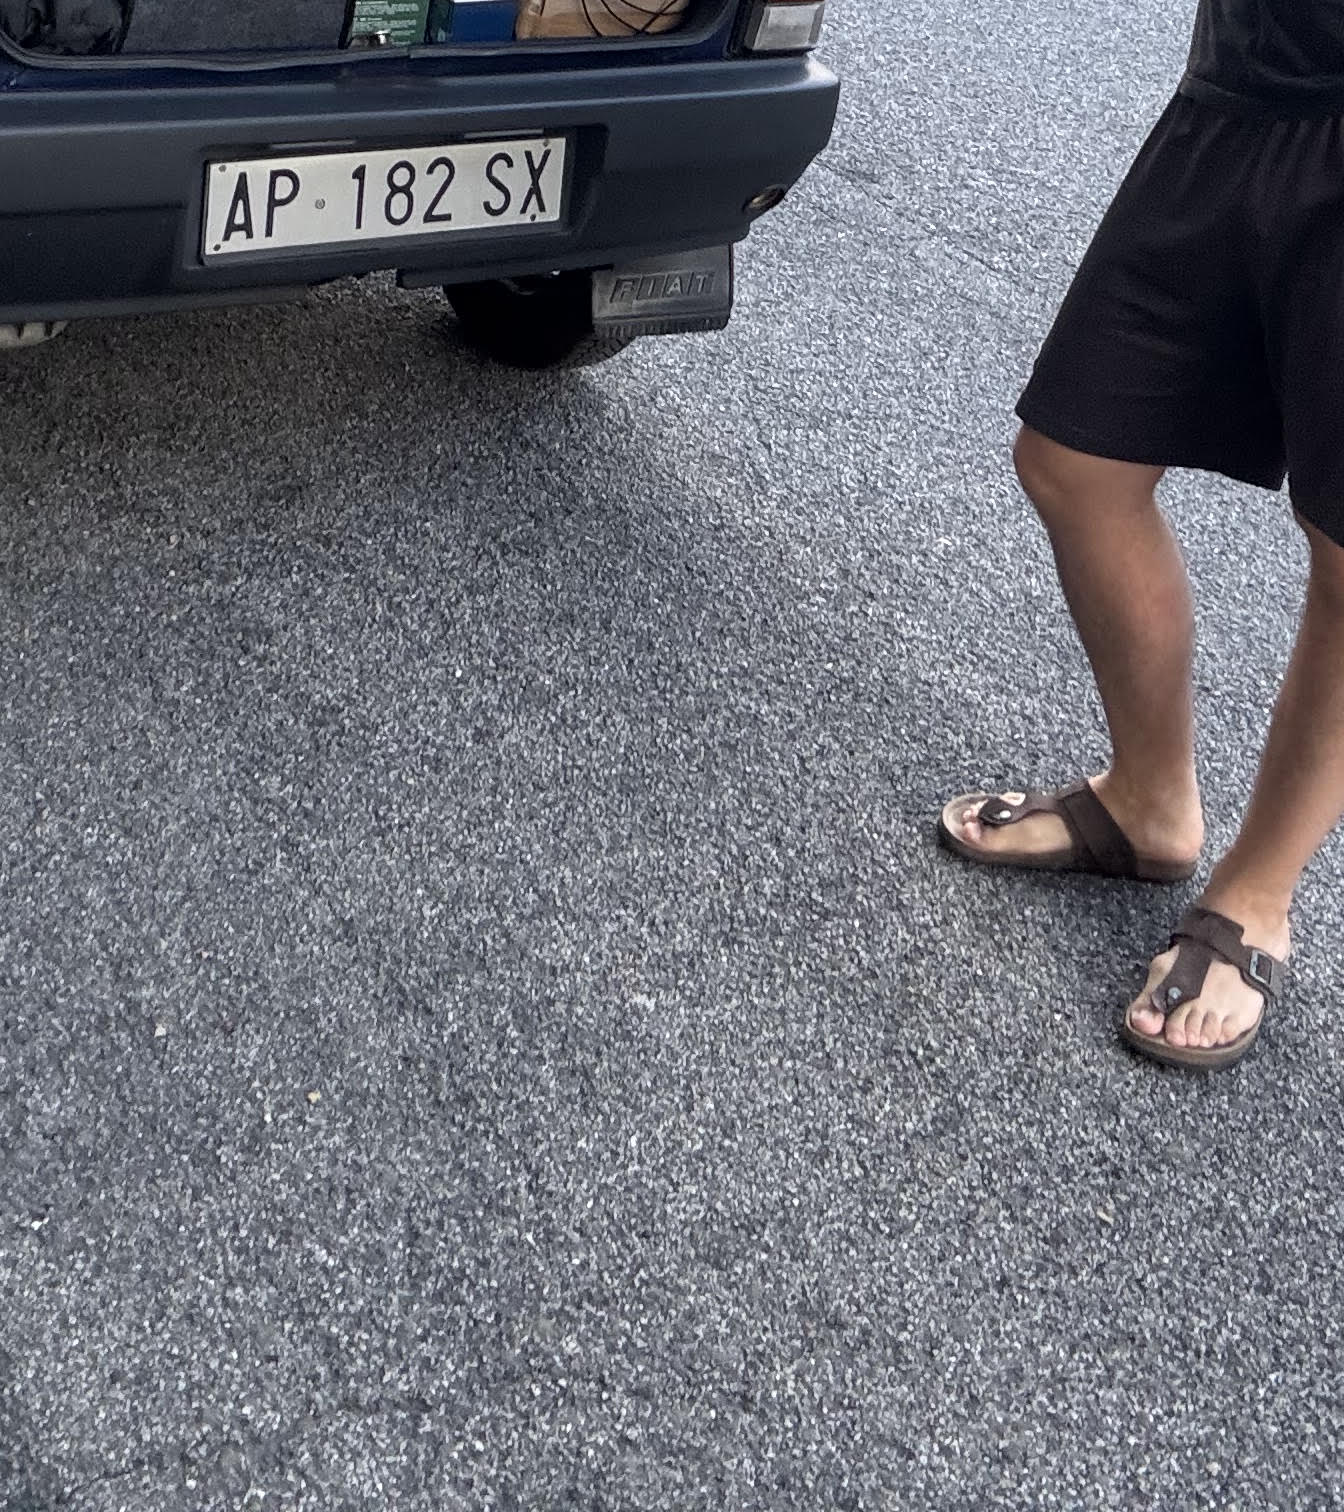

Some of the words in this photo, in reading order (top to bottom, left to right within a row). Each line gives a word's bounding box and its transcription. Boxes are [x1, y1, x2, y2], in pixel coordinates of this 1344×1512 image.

[222, 168, 301, 242] AP
[351, 155, 456, 230] 182
[482, 148, 552, 217] SX
[611, 273, 711, 302] FIAT
